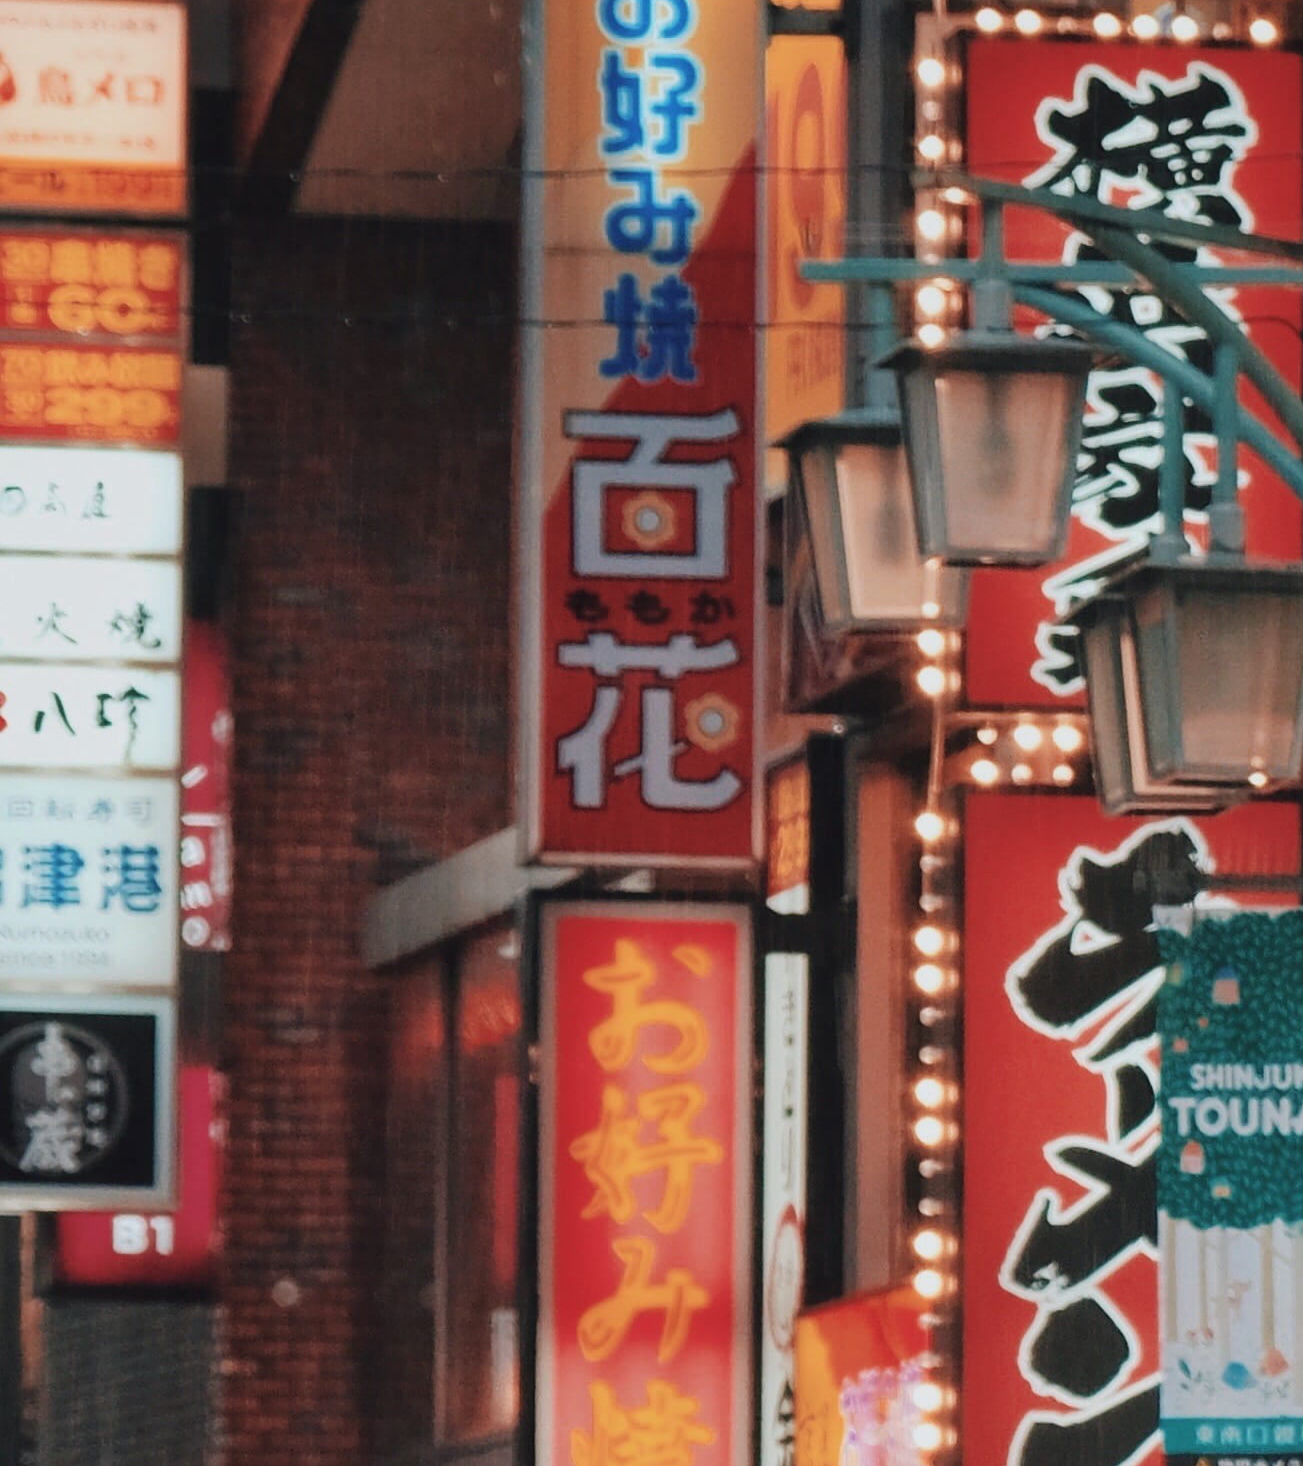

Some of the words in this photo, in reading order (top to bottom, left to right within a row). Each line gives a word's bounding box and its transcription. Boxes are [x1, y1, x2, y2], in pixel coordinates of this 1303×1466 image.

[556, 409, 743, 812] 百花
[566, 589, 737, 627] ももか
[0, 843, 162, 913] 津港
[112, 1214, 174, 1255] B1
